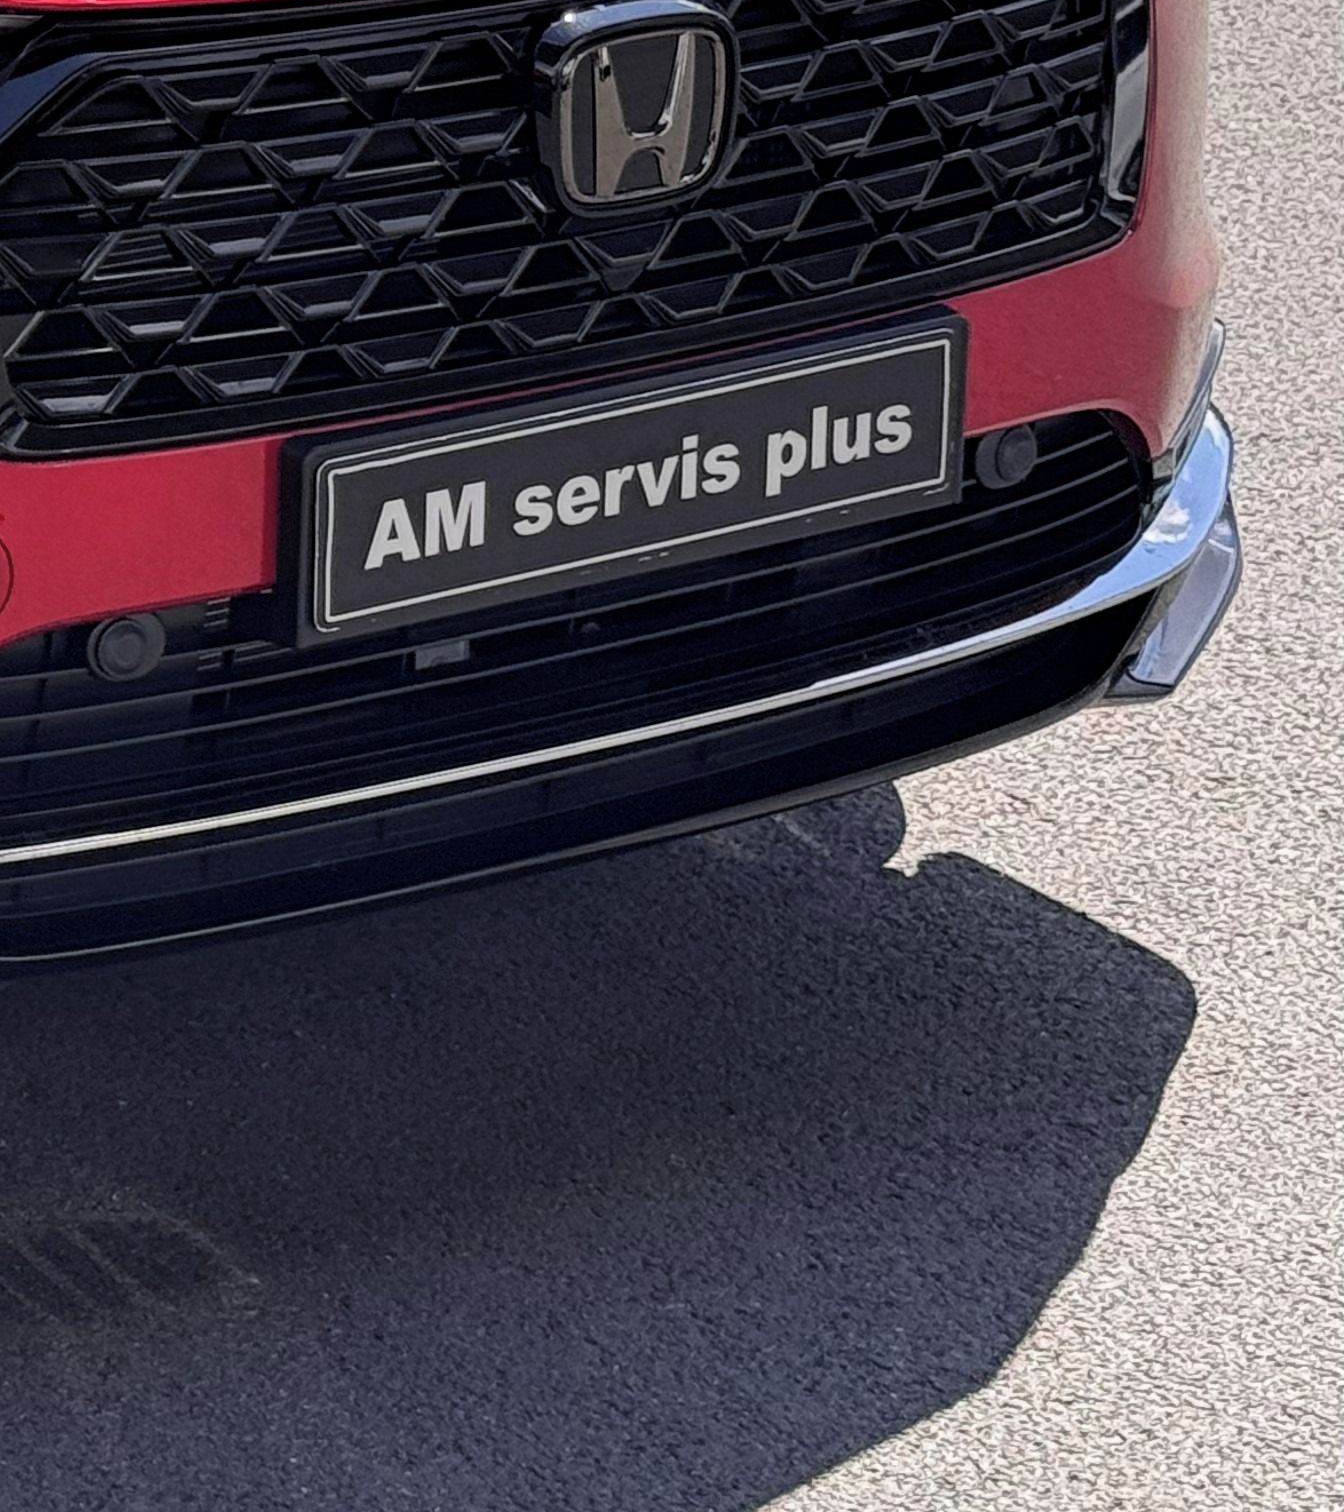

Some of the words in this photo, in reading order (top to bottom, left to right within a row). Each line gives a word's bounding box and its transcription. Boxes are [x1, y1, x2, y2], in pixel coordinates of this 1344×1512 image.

[364, 481, 486, 570] AM
[513, 434, 741, 536] servis
[765, 404, 912, 497] plus
